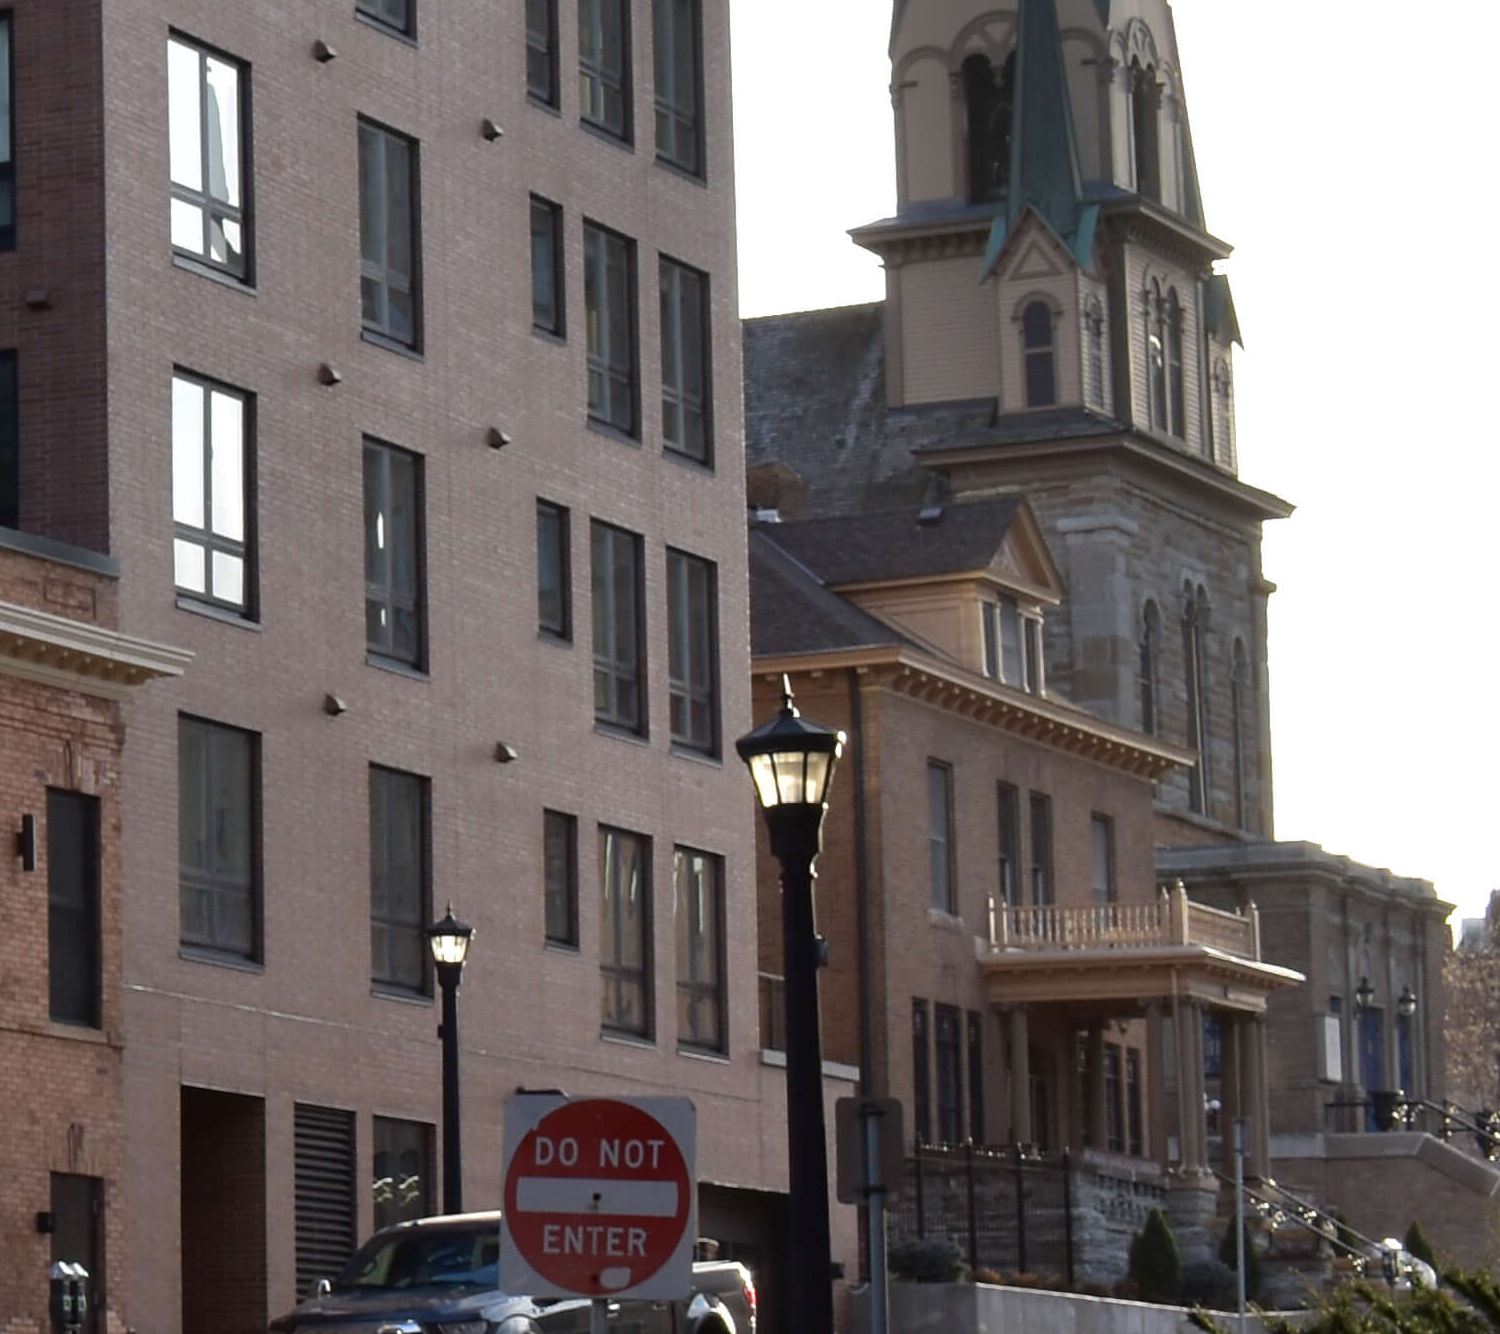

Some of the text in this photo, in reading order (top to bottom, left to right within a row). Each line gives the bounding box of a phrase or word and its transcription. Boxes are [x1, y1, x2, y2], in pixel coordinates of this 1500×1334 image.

[535, 1136, 665, 1169] DO NOT
[543, 1224, 647, 1257] ENTER
